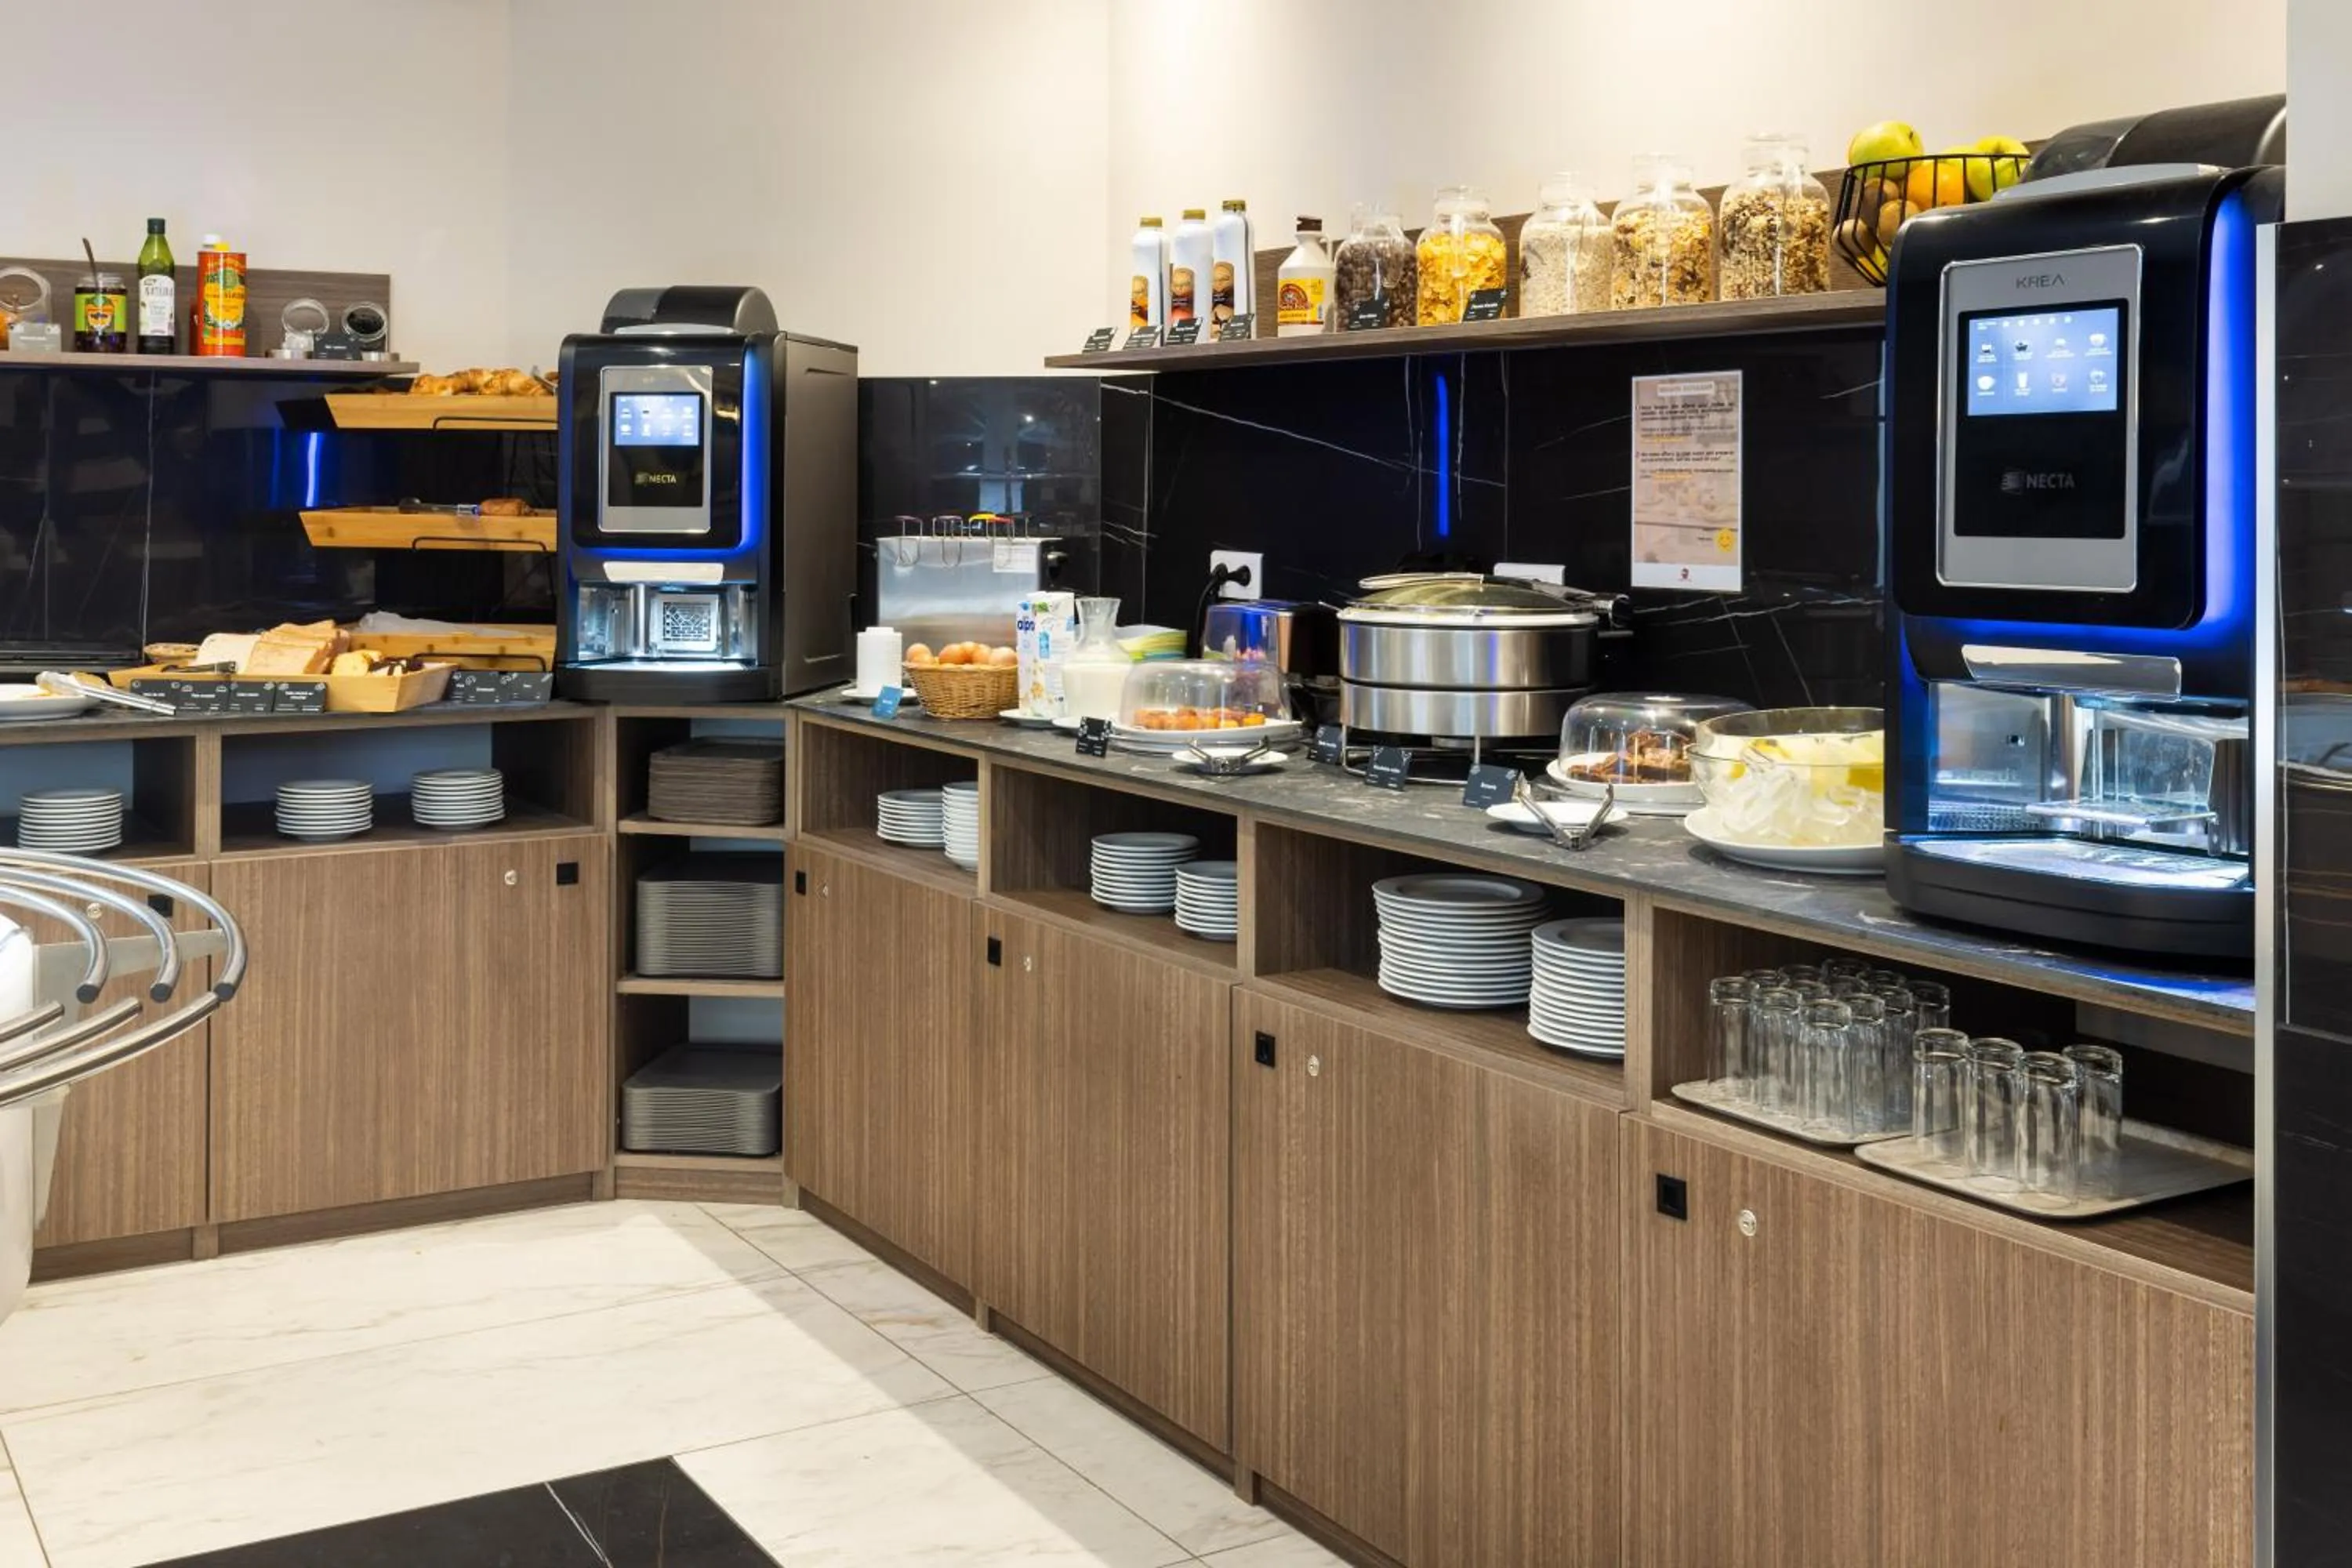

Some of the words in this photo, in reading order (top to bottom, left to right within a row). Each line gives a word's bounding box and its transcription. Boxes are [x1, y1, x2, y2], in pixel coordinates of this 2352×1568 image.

[2016, 274, 2065, 289] KREA
[649, 474, 677, 484] NECTA
[2026, 473, 2075, 489] NECTA
